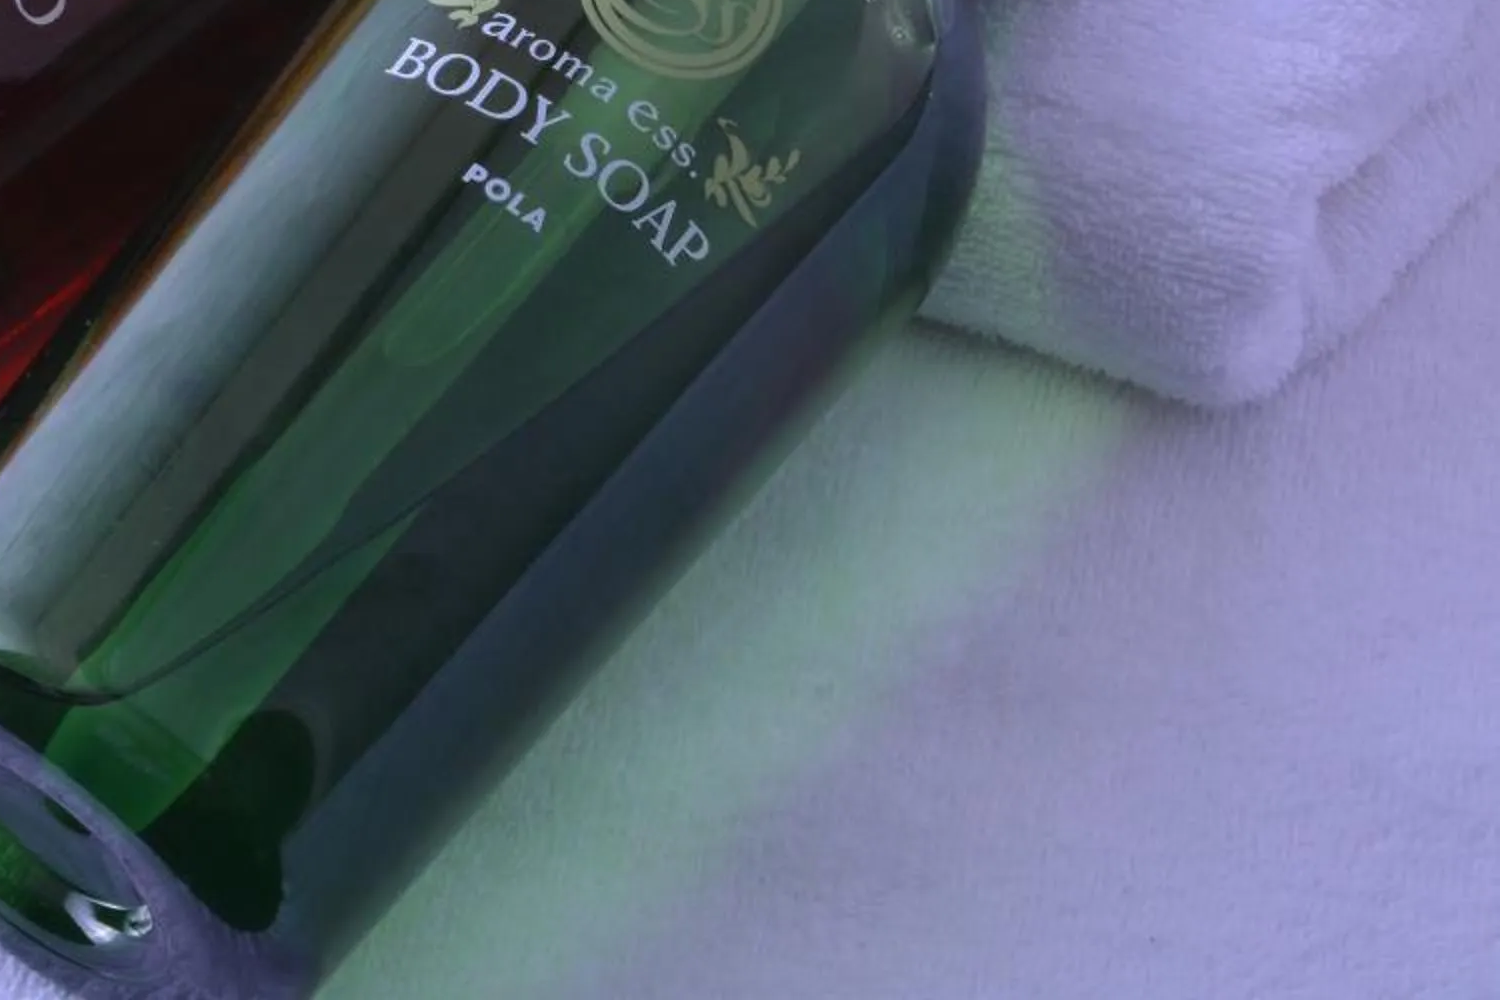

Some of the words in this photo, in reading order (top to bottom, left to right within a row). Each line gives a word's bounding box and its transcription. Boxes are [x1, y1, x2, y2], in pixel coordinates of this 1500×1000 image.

[386, 37, 571, 145] BODY
[564, 132, 709, 266] SOAP
[481, 12, 618, 102] aroma
[627, 100, 698, 178] ess.
[462, 163, 546, 232] POLA
